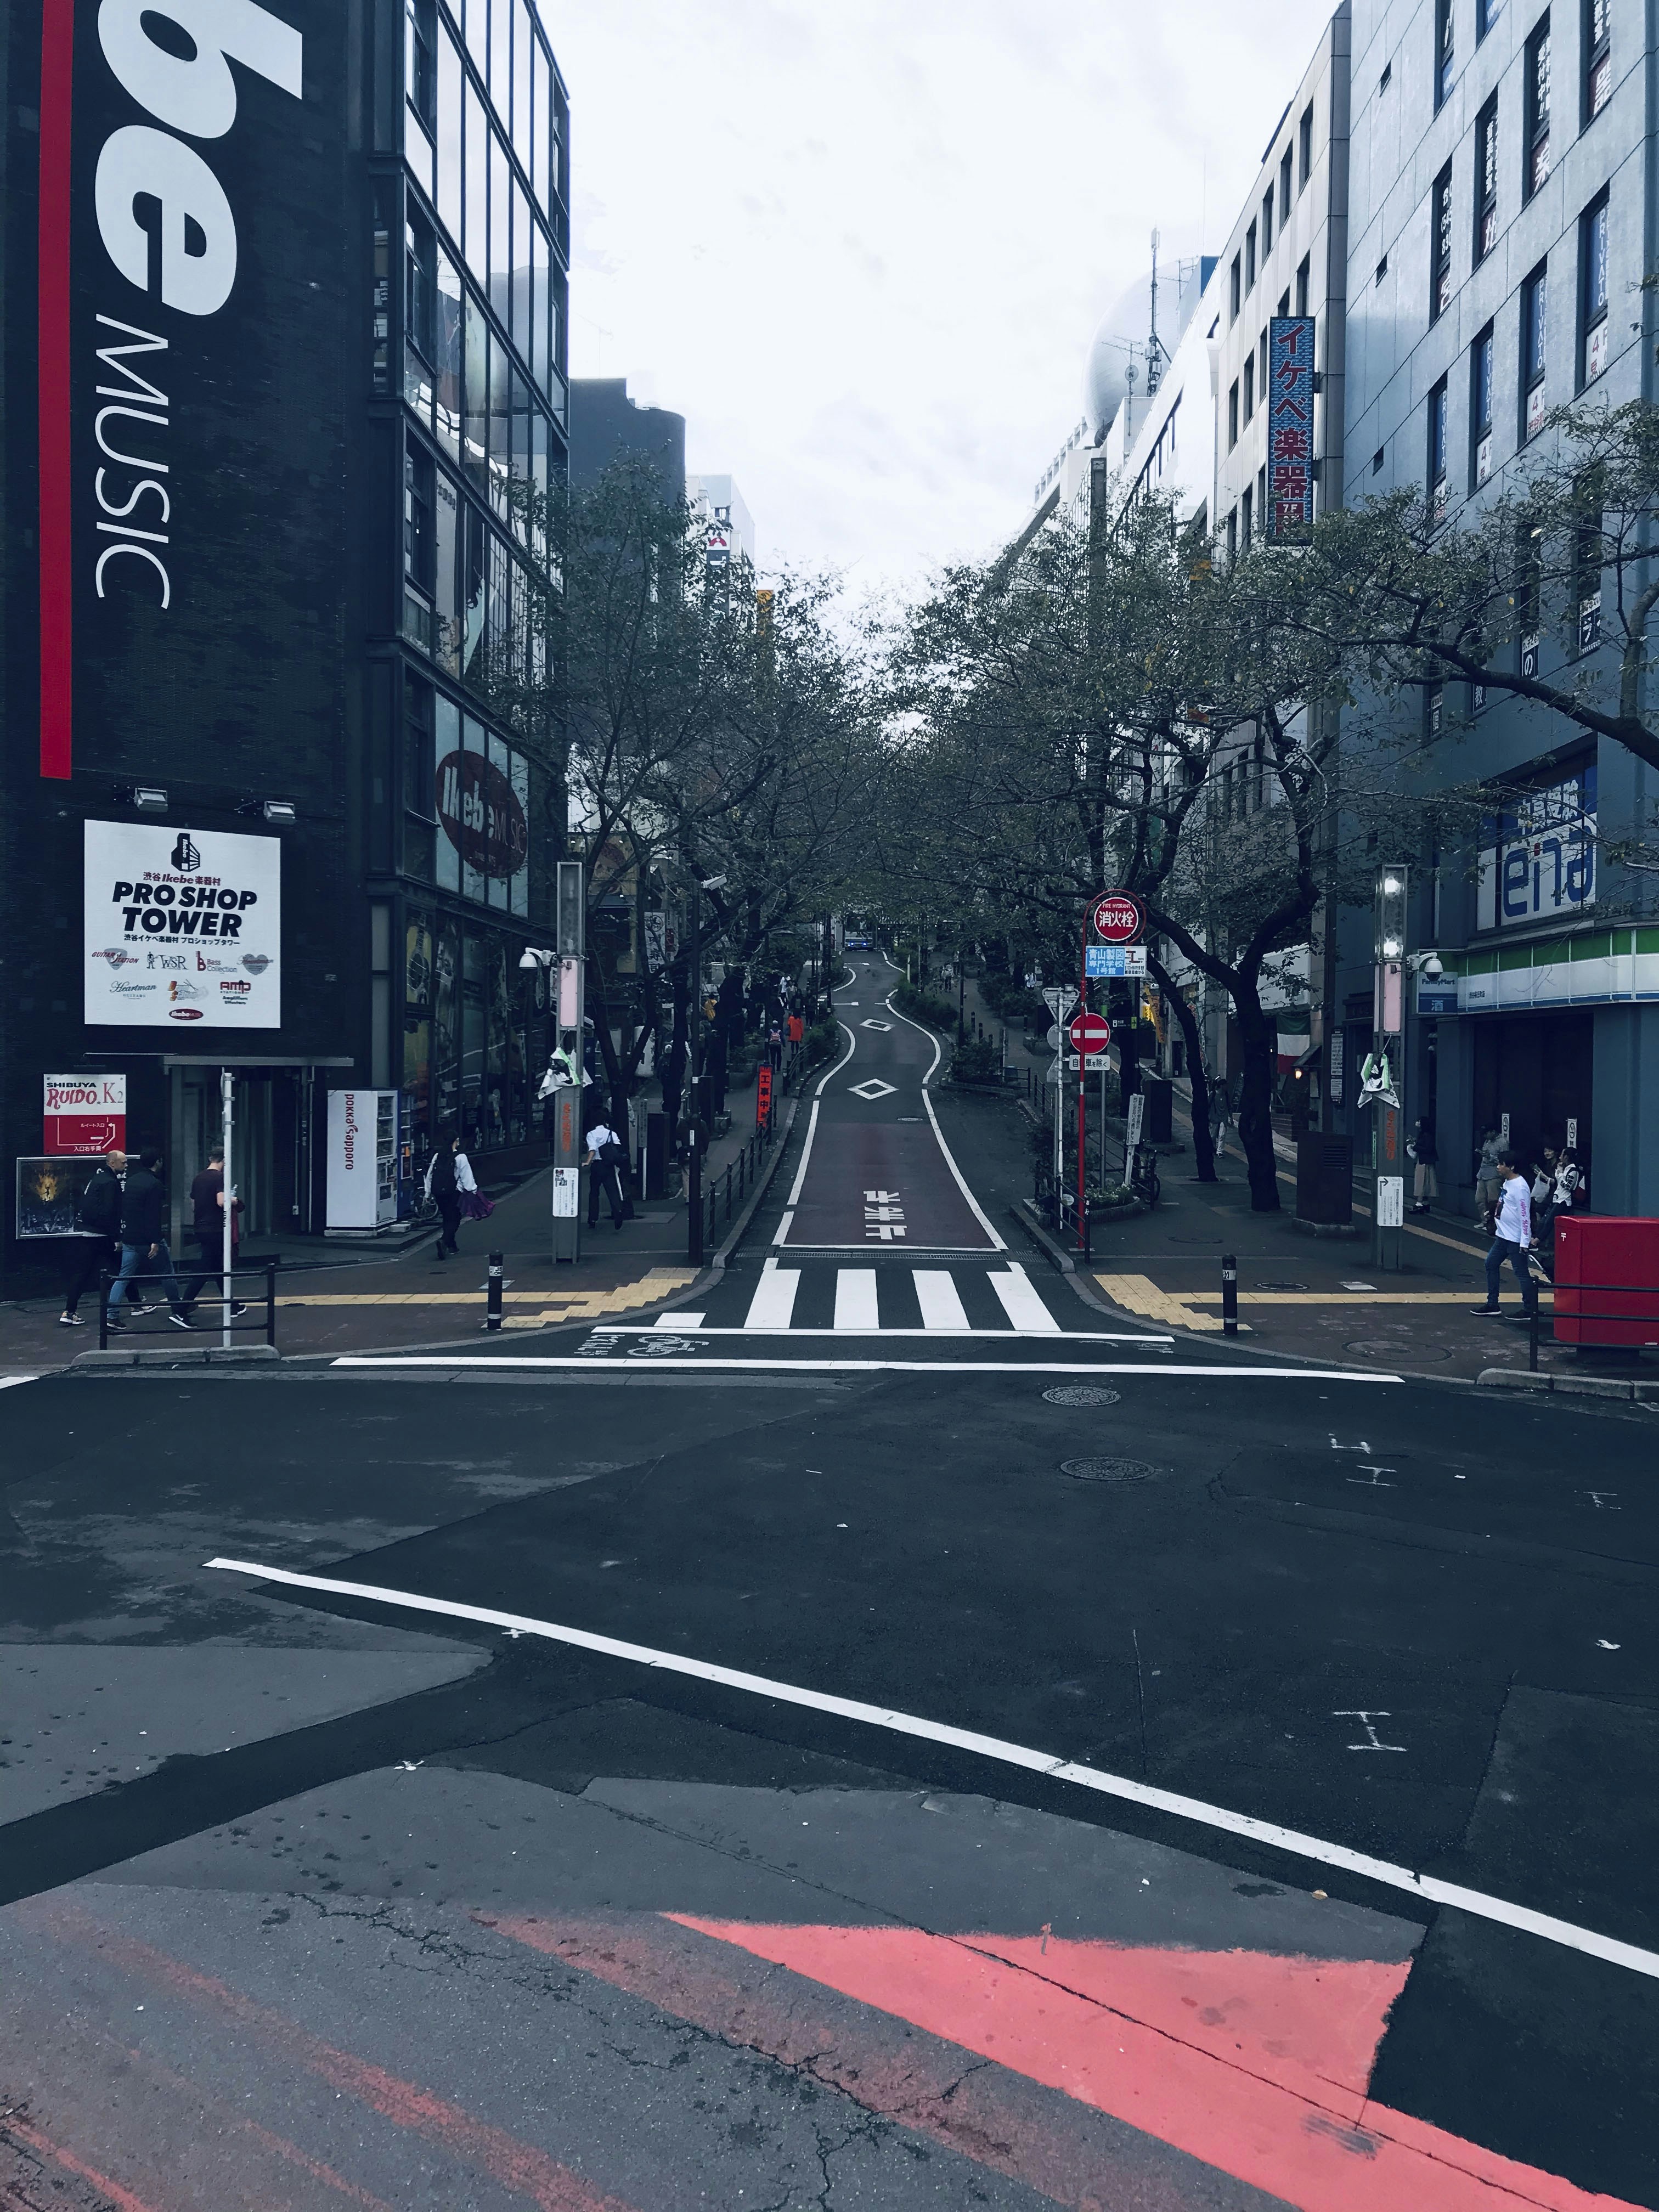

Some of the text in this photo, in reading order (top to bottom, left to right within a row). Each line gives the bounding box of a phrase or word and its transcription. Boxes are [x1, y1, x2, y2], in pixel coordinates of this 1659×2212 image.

[1598, 209, 1606, 306] PRIVATO
[1537, 279, 1545, 369] PRIVATO
[95, 313, 170, 610] MUSIC
[112, 881, 257, 911] PRO SHOP
[122, 906, 242, 937] TOWER
[1099, 911, 1134, 927] 消火栓
[1088, 948, 1124, 960] 青山製図
[109, 980, 157, 993] Heartman
[1431, 1000, 1444, 1012] 酒
[1073, 1058, 1107, 1068] 自車を除く
[103, 1082, 123, 1104] K2
[343, 1094, 354, 1170] pokka sapporo
[863, 1190, 908, 1240] 止まれ
